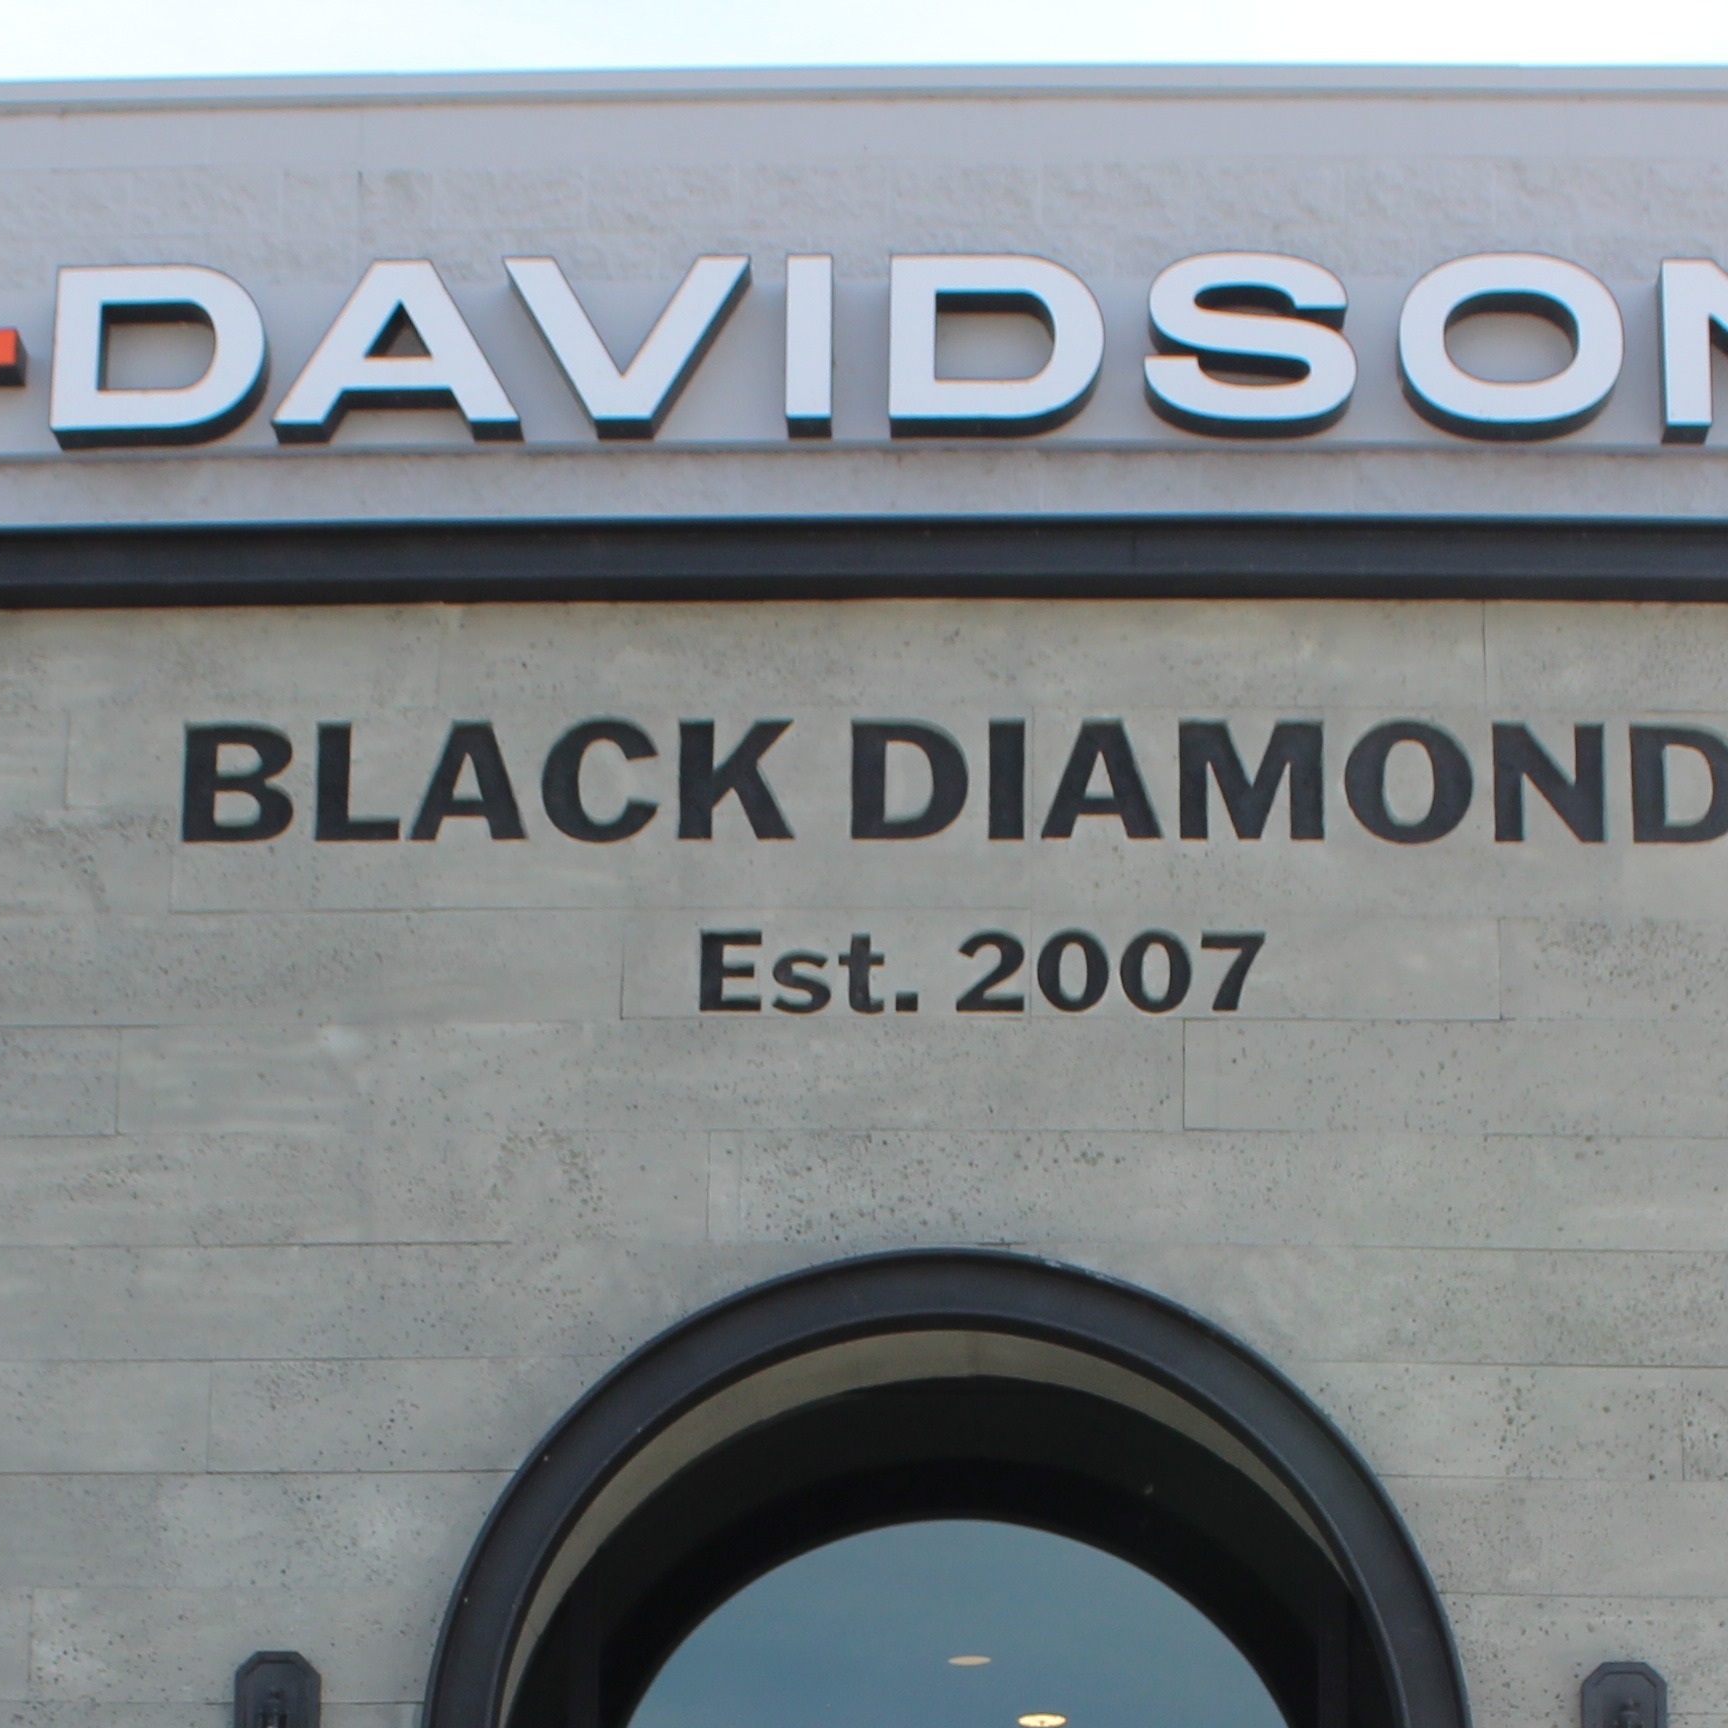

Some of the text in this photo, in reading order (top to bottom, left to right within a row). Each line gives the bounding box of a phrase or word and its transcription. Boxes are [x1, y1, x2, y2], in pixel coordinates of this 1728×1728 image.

[180, 718, 797, 844] BLACK
[698, 928, 1267, 1014] Est. 2007
